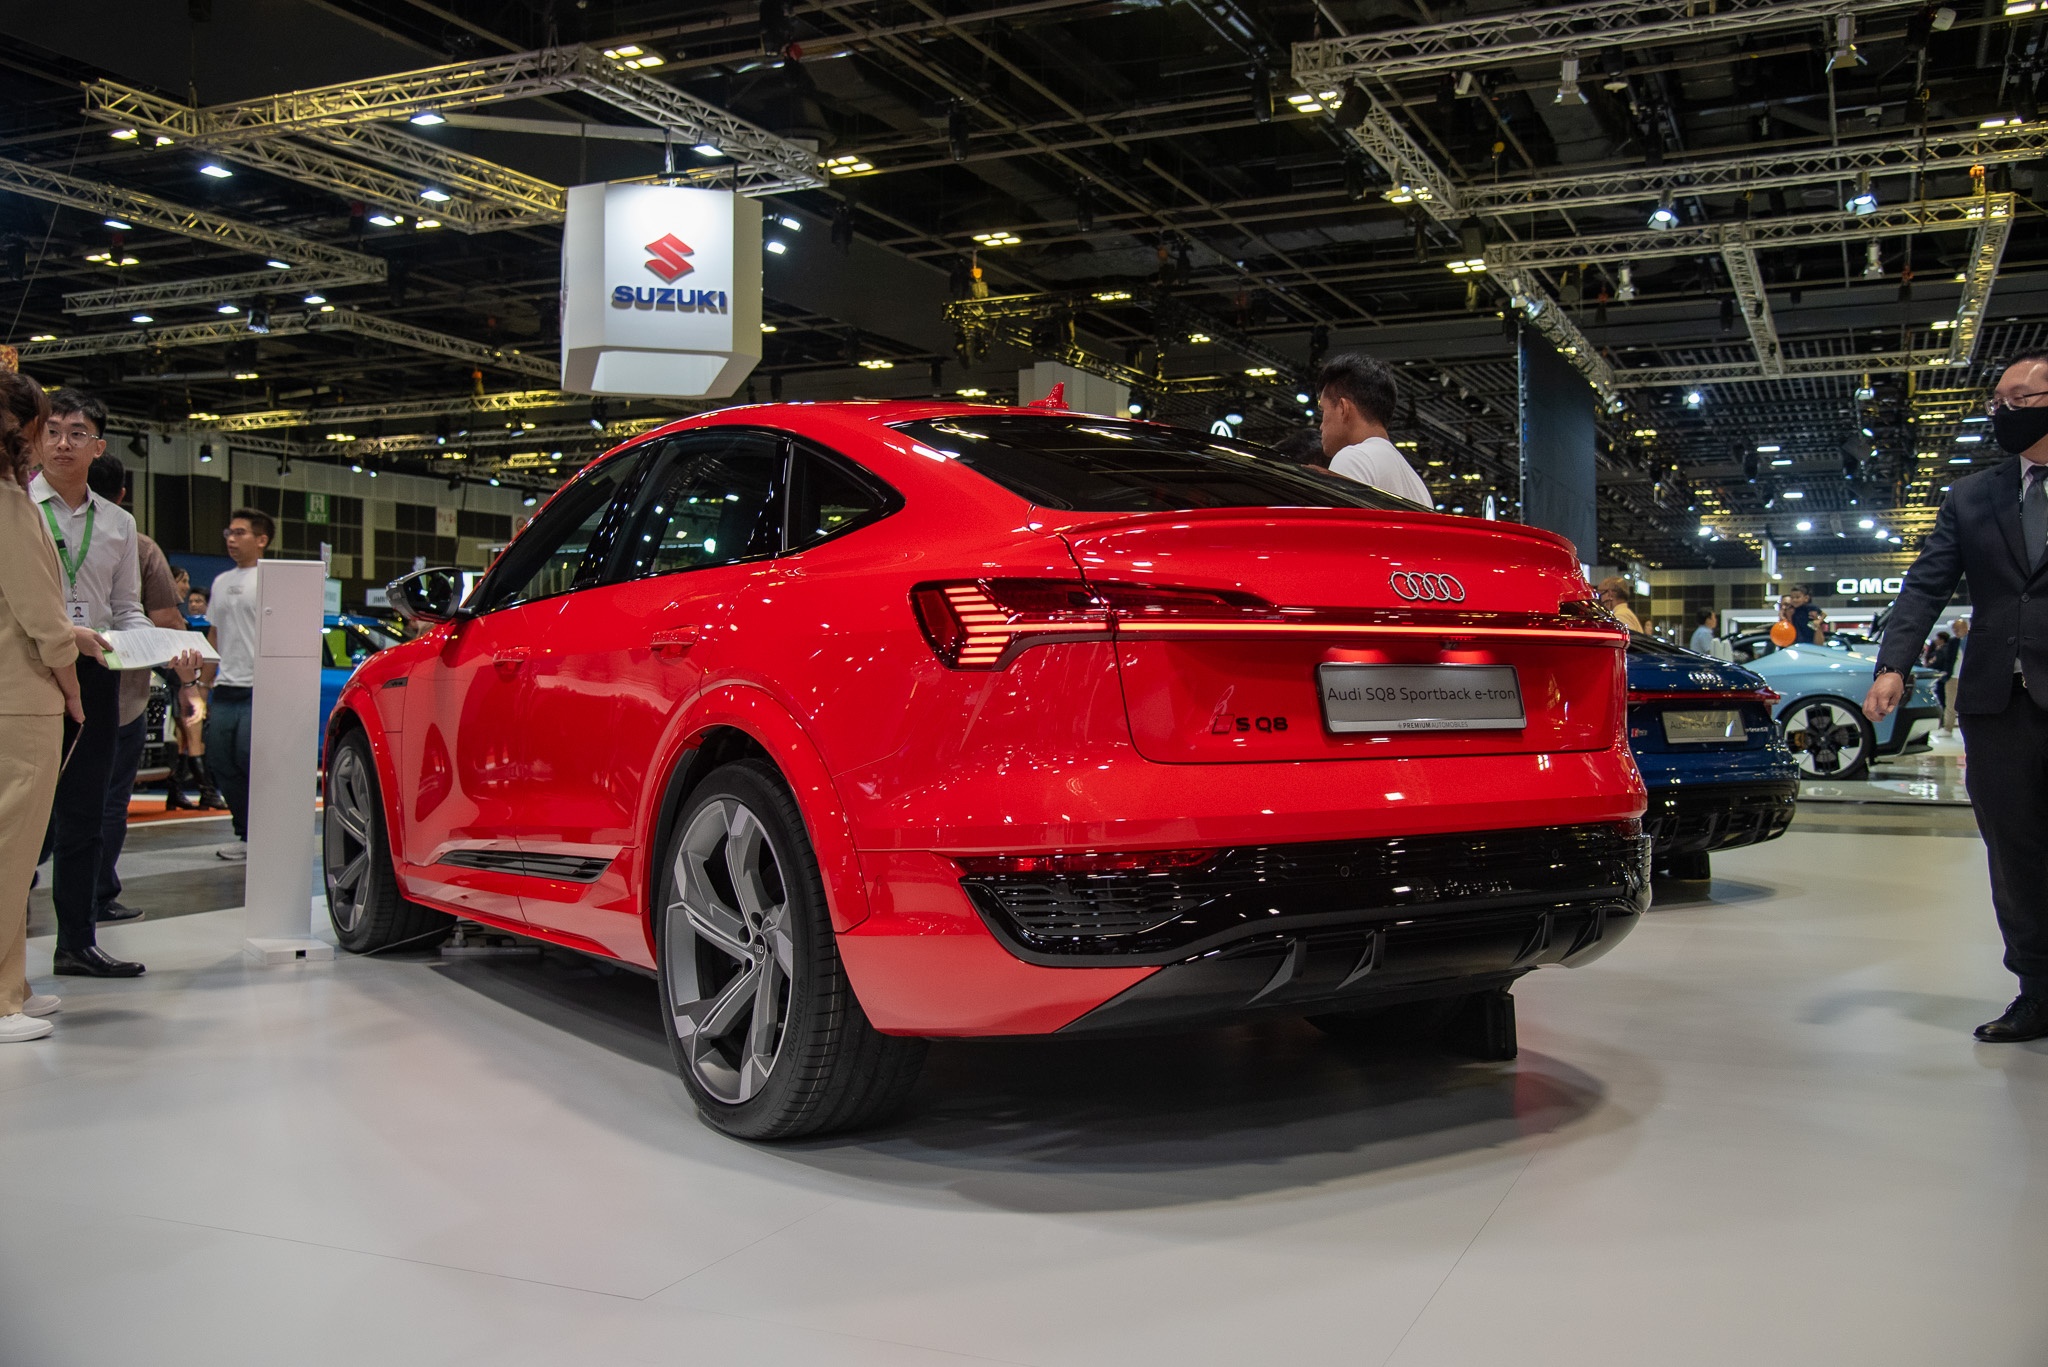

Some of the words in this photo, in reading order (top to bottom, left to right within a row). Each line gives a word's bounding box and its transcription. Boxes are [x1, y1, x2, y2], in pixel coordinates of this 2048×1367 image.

[613, 285, 727, 312] SUZUKI
[1327, 687, 1362, 701] Audi
[1365, 687, 1396, 702] SQ8
[1399, 687, 1472, 703] Sportback
[1474, 688, 1516, 700] e-tron
